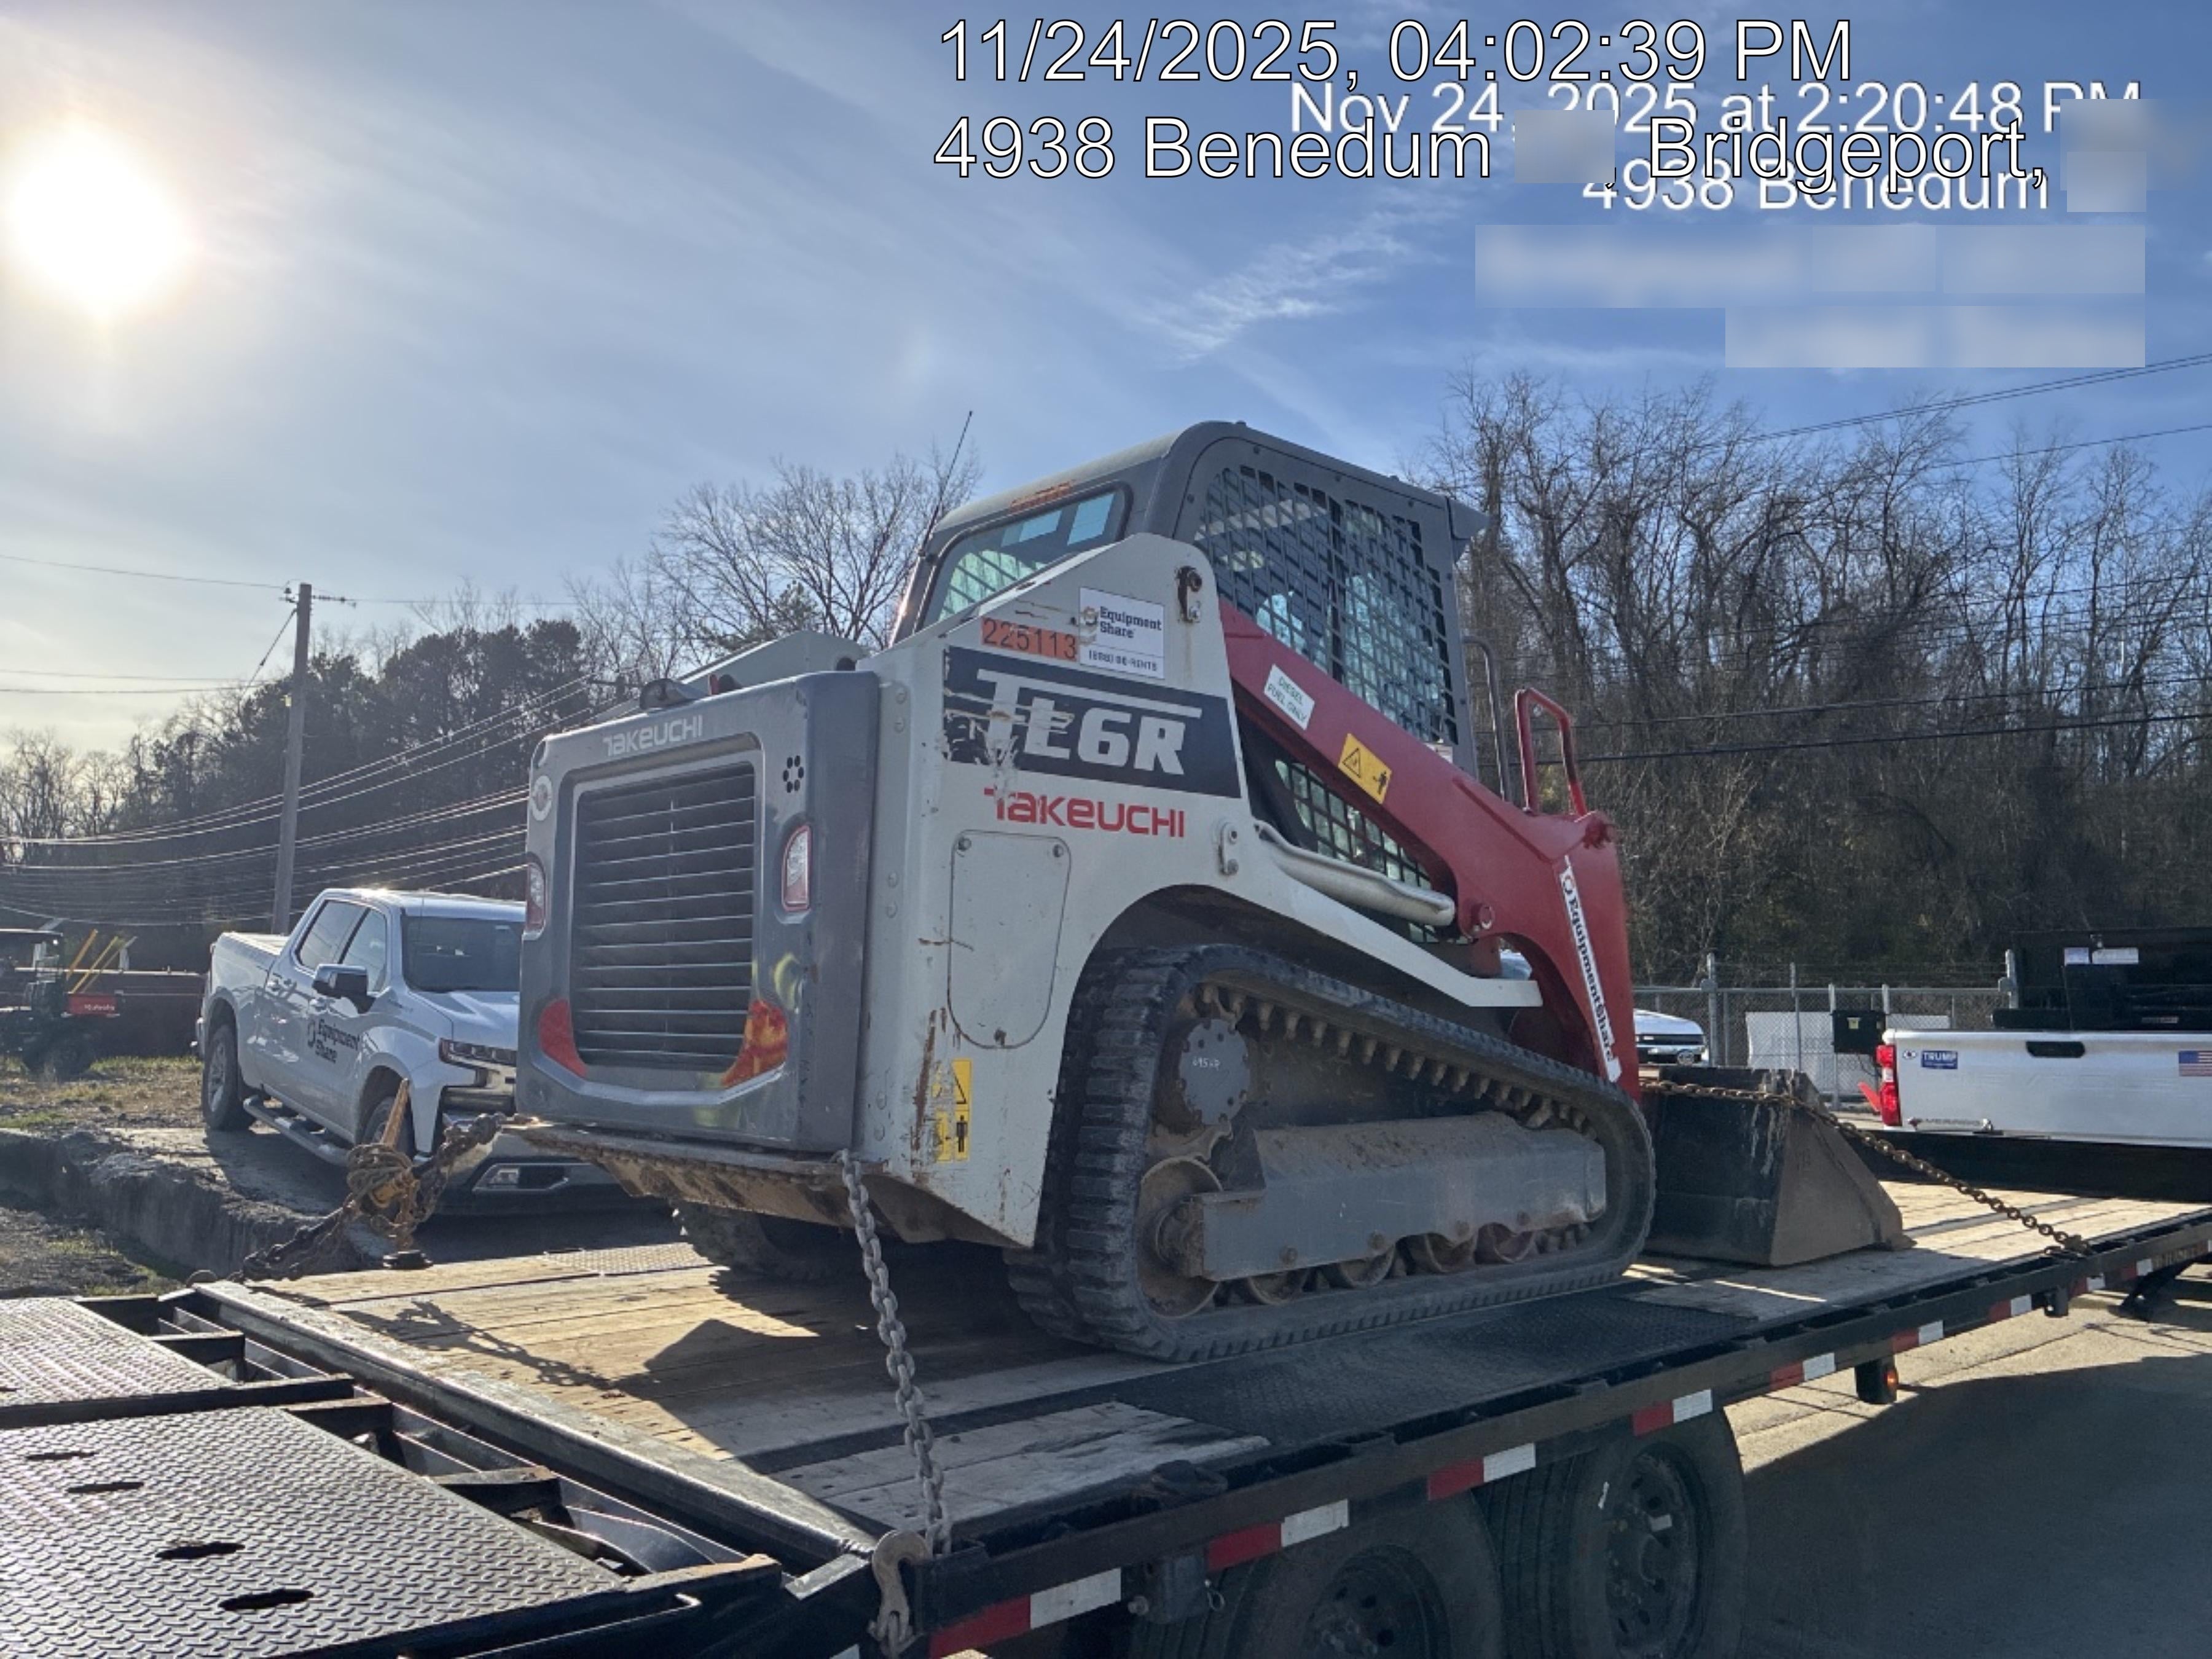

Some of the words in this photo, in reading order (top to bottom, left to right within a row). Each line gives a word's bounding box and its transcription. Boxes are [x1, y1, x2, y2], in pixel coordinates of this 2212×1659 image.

[1100, 606, 1161, 630] Equipment
[1100, 621, 1134, 638] Share
[982, 618, 1078, 661] 225113
[318, 1018, 360, 1051] Equipment
[315, 1039, 338, 1064] Share
[1924, 1051, 1957, 1062] TRUMP
